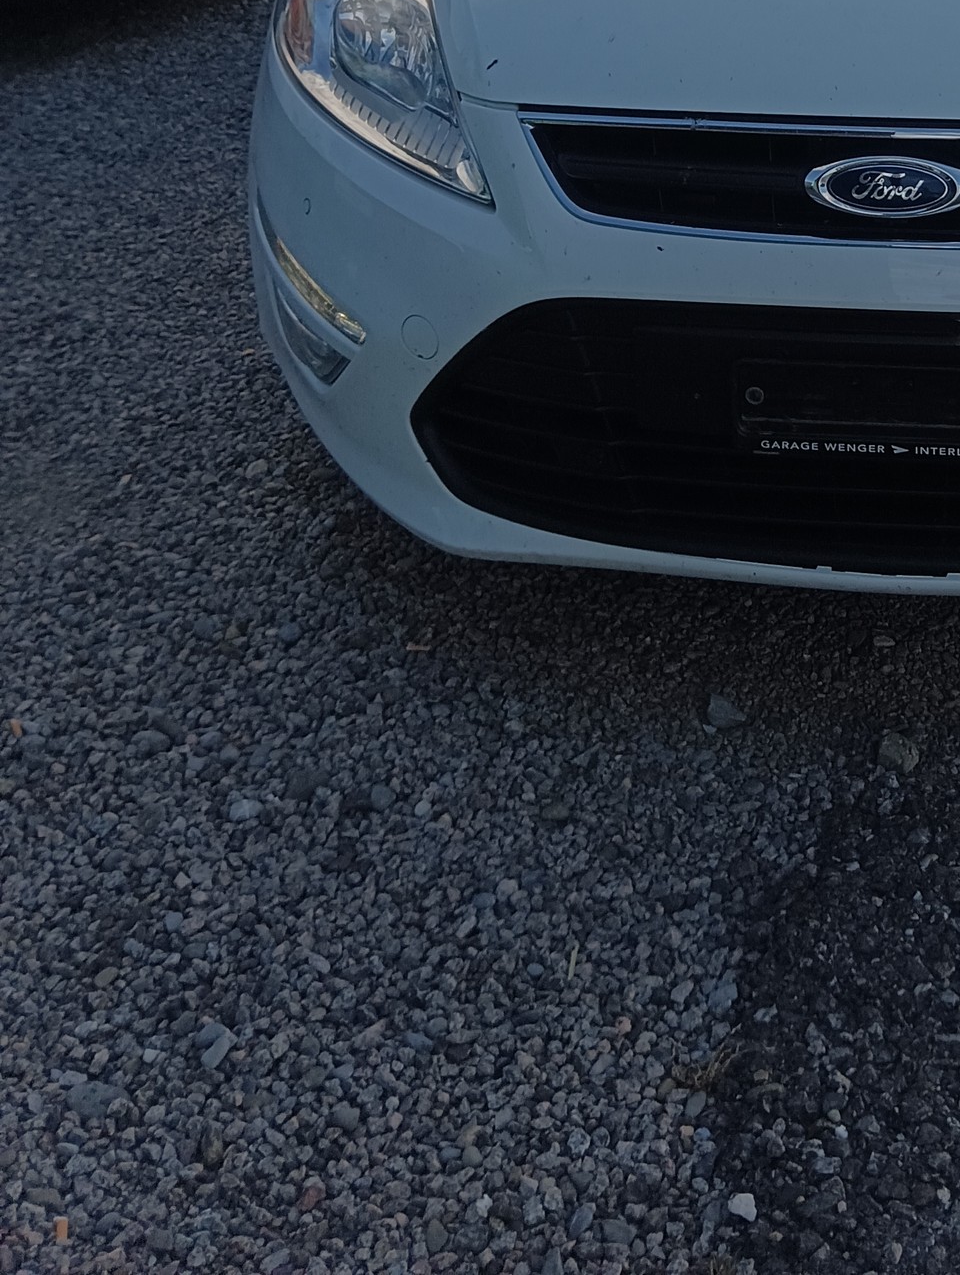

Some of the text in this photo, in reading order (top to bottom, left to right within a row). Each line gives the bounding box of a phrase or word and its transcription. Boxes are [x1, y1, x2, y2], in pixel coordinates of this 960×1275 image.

[852, 171, 925, 201] Ford
[760, 440, 819, 451] GARAGE
[824, 442, 885, 454] WENGER
